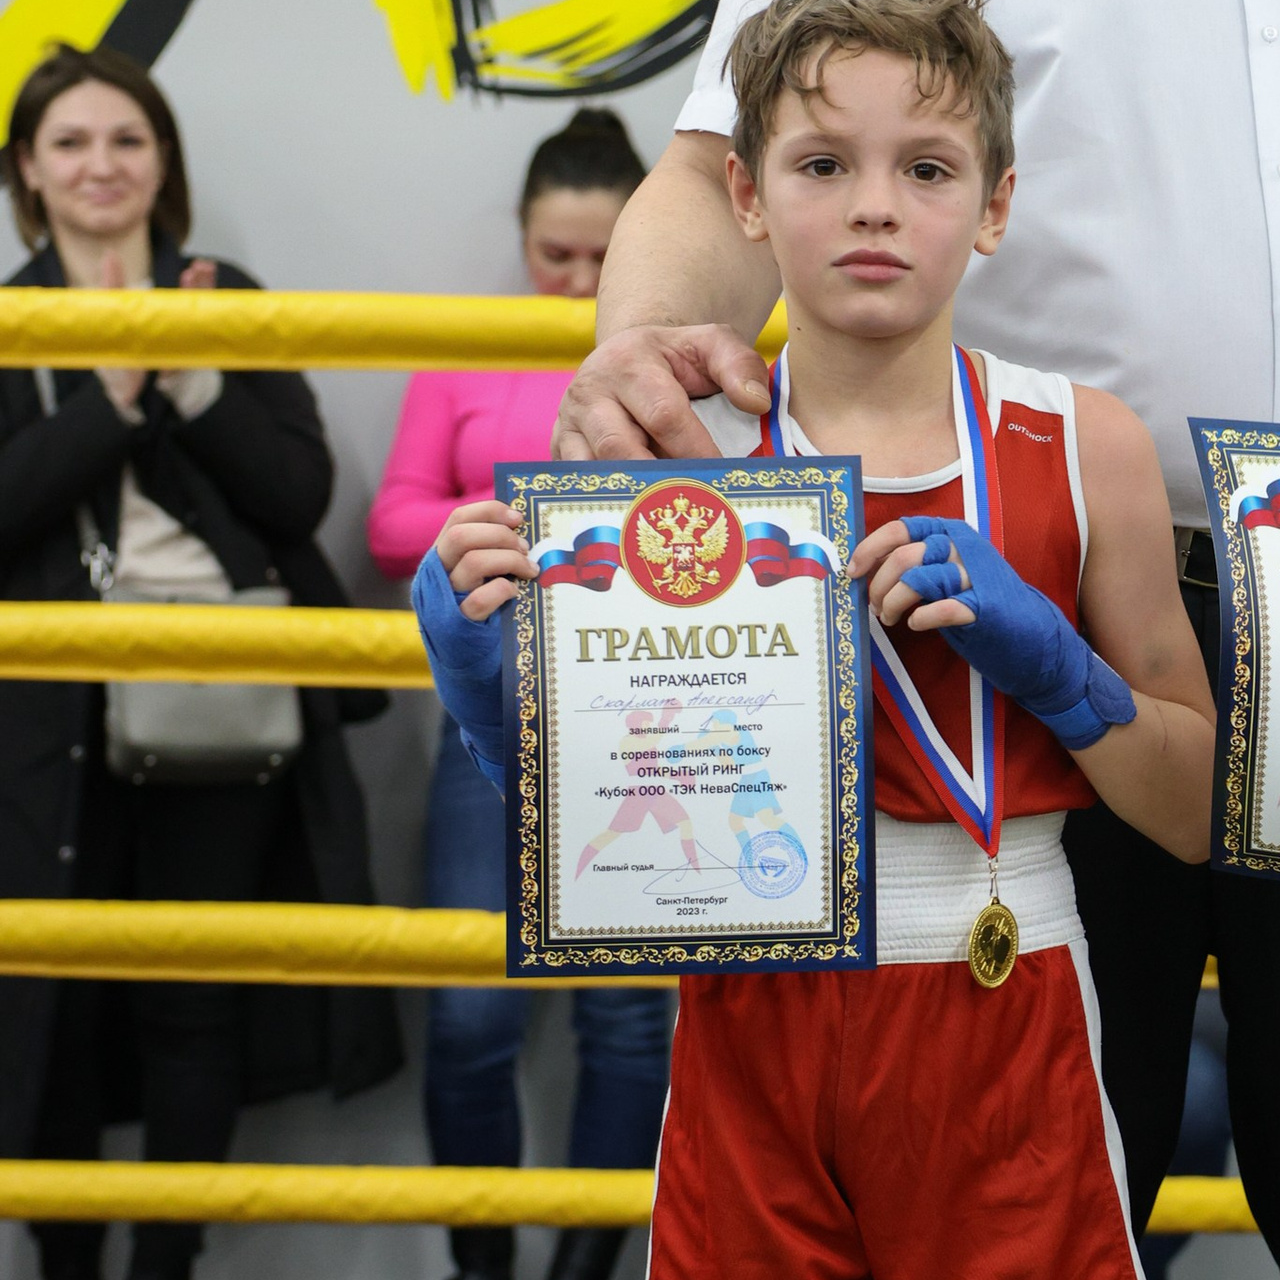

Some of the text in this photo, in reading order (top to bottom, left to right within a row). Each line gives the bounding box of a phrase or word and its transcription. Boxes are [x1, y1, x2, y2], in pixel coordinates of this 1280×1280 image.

[1007, 422, 1053, 443] OUTSHOCK
[575, 623, 799, 662] ГРАМОТА
[630, 672, 747, 688] НАГРАЖДАЕТСЯ
[629, 714, 763, 735] занявший 1 место
[610, 744, 771, 761] в соревнованиях по боксу
[637, 763, 745, 778] ОТКРЫТЫЙ РИНГ
[638, 785, 666, 796] ООО
[593, 863, 655, 873] Главный судья
[656, 895, 729, 906] Санкт-Петербург
[676, 908, 700, 916] 2023
